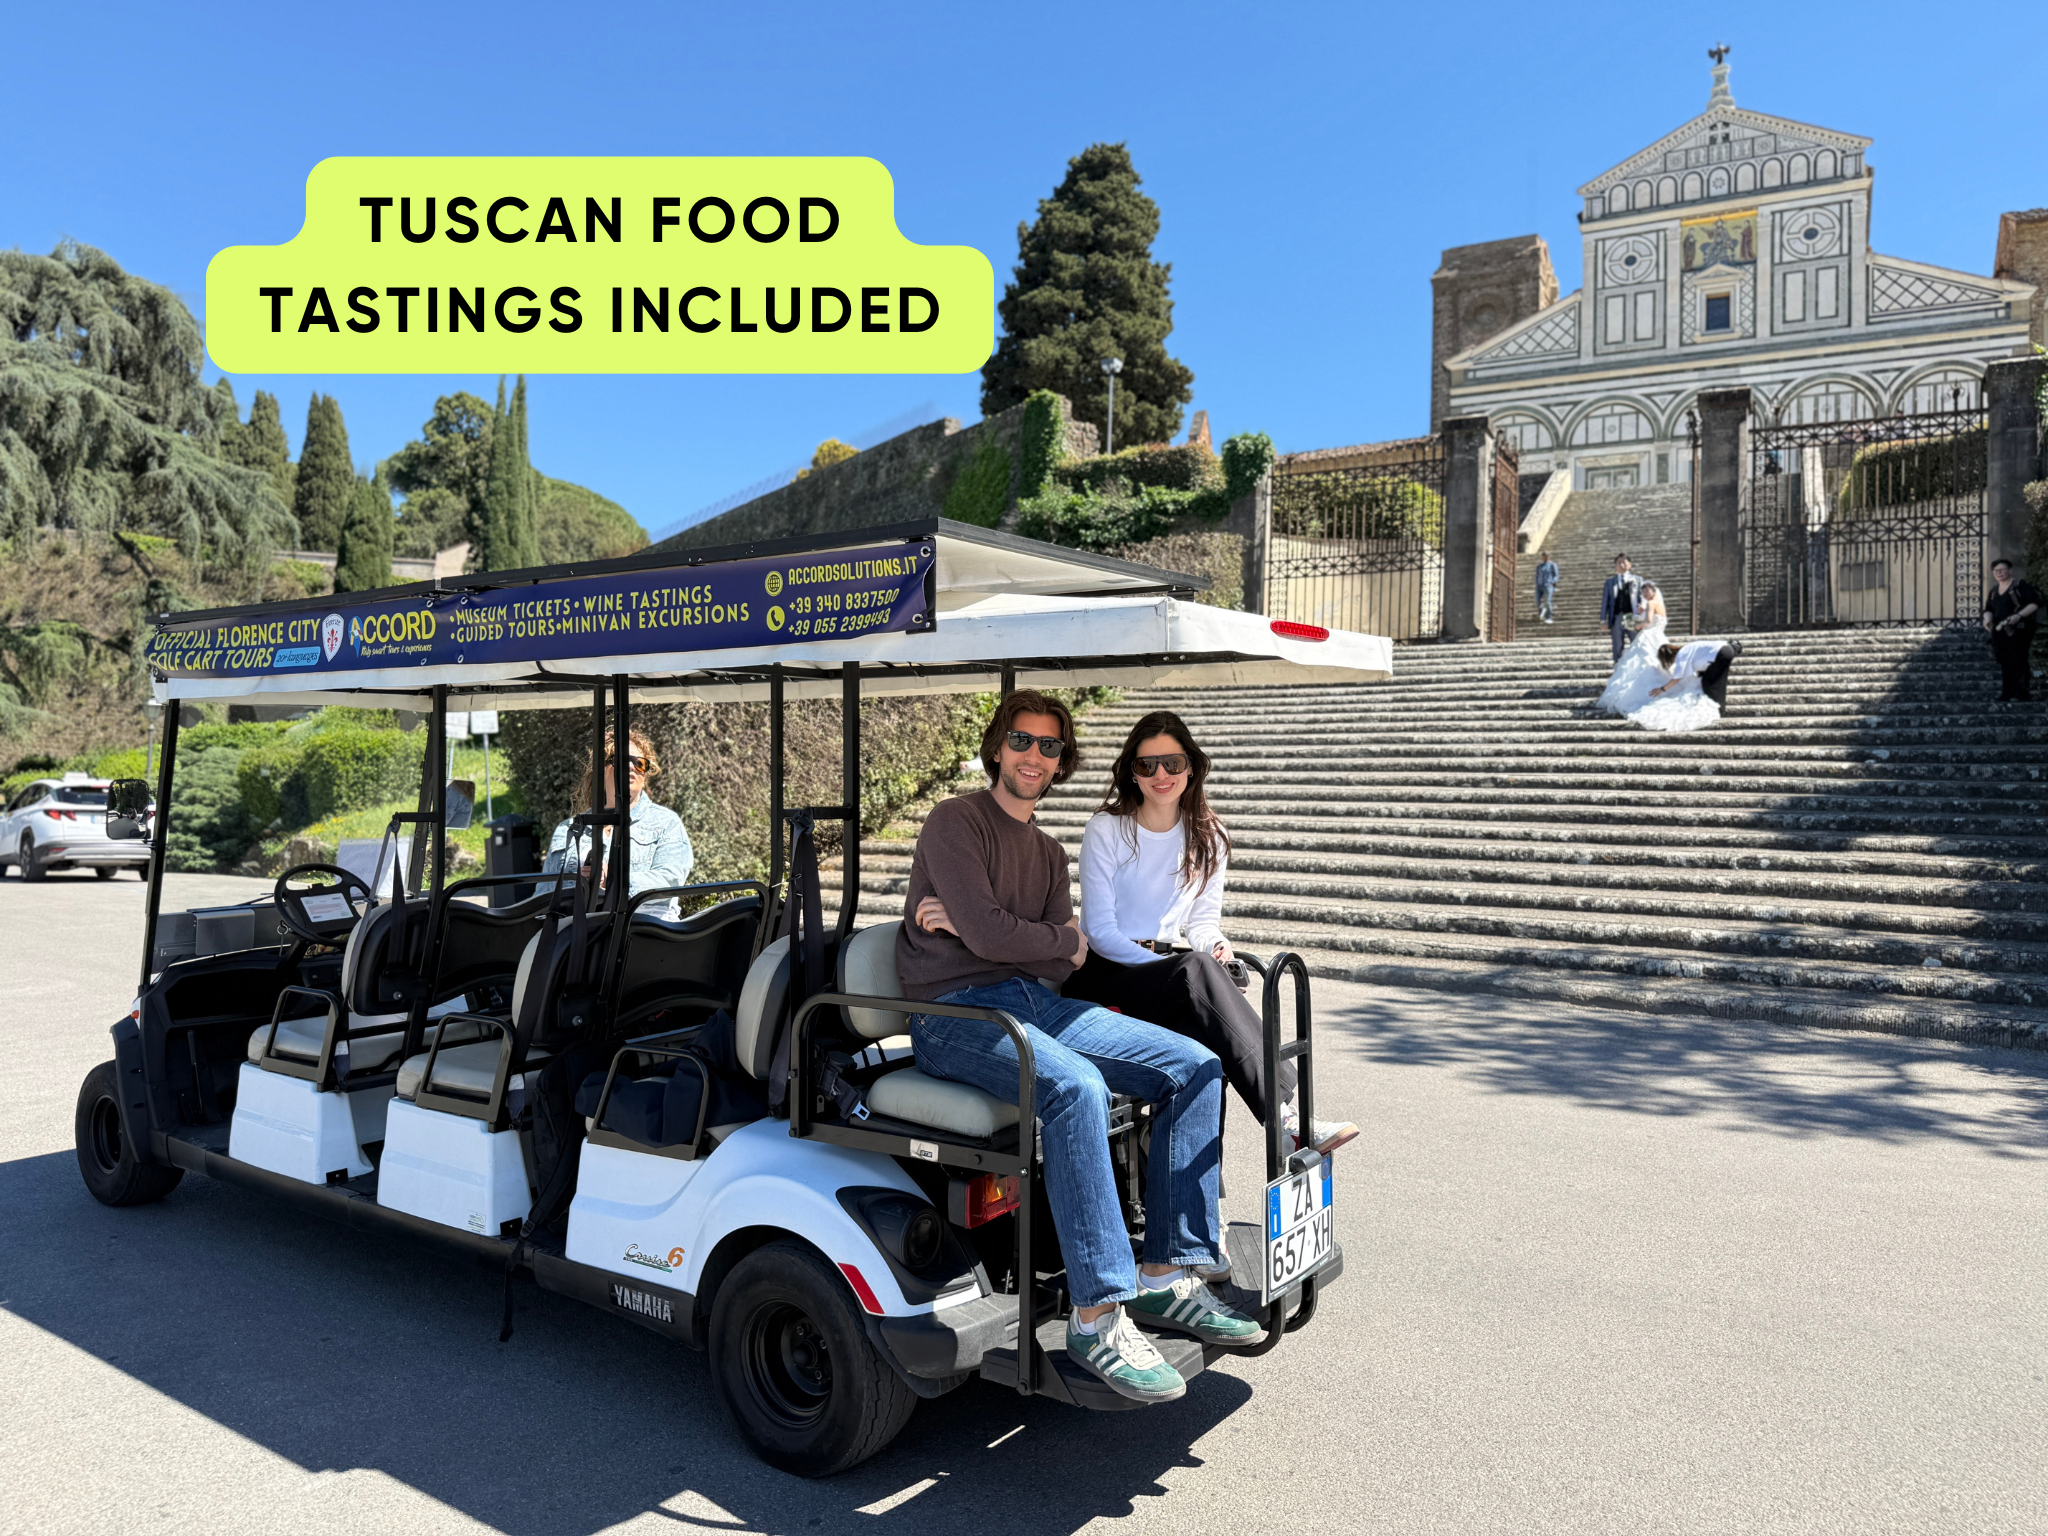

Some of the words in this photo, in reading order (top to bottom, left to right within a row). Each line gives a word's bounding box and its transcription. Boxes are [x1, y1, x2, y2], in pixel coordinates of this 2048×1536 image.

[788, 556, 918, 585] ACCORDSOLUTIONS.IT
[455, 604, 508, 625] MUSEUM
[513, 598, 571, 620] TICKETS
[583, 593, 623, 613] WINE
[630, 585, 713, 610] TASTINGS
[789, 597, 811, 614] +39
[817, 594, 841, 613] 340
[846, 588, 900, 610] 8337500
[154, 629, 211, 651] OFFICIAL
[215, 622, 284, 648] FLORENCE
[288, 618, 321, 643] CITY
[349, 610, 437, 646] ACCORD
[456, 623, 504, 643] GUIDED
[638, 603, 750, 629] EXCURSIONS
[788, 619, 810, 636] +39
[814, 617, 838, 635] 055
[184, 650, 223, 671] CART
[223, 647, 274, 669] TOURS
[1293, 1173, 1314, 1223] ZA
[668, 1246, 685, 1268] 6
[1273, 1226, 1306, 1283] 657
[1312, 1208, 1330, 1260] XH
[614, 1284, 672, 1323] YAMAHA
